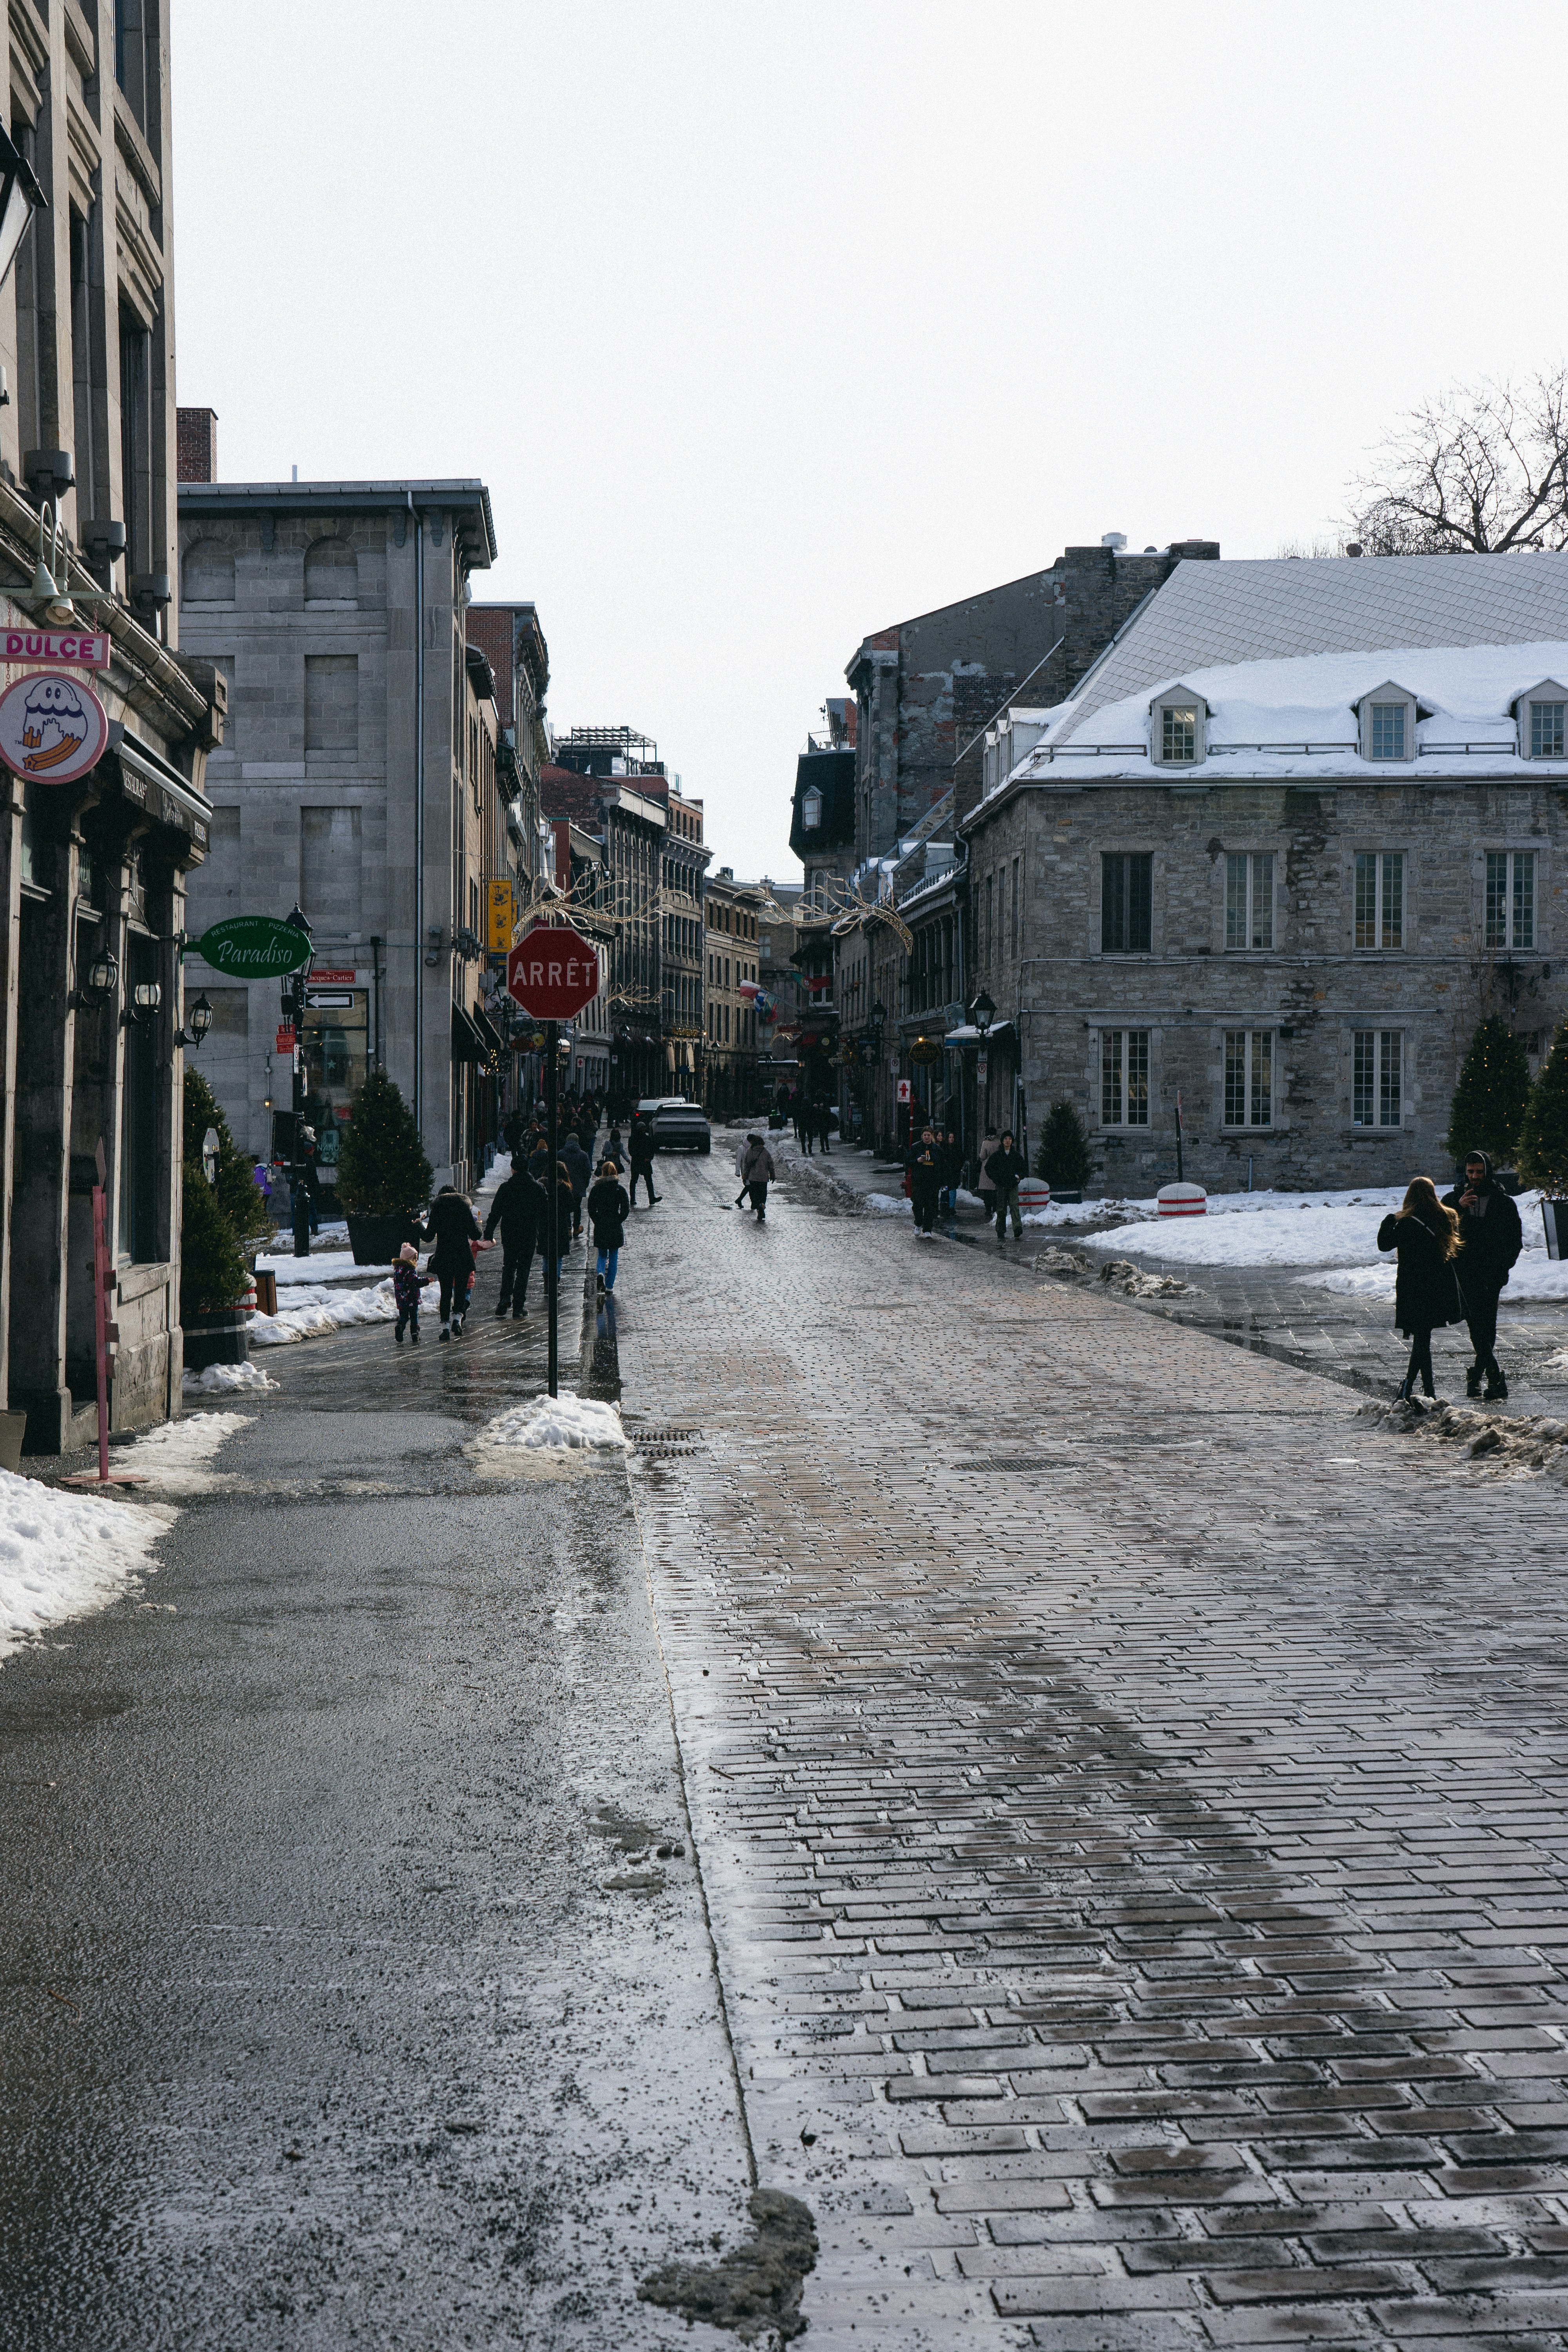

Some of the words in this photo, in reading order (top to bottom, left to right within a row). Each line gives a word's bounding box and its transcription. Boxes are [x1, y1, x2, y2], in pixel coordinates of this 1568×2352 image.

[6, 634, 94, 659] DULCE
[211, 921, 258, 937] RESTAURANT
[269, 922, 299, 939] PIZZERIA
[218, 936, 292, 963] Paradiso
[512, 958, 594, 986] ARRÊT
